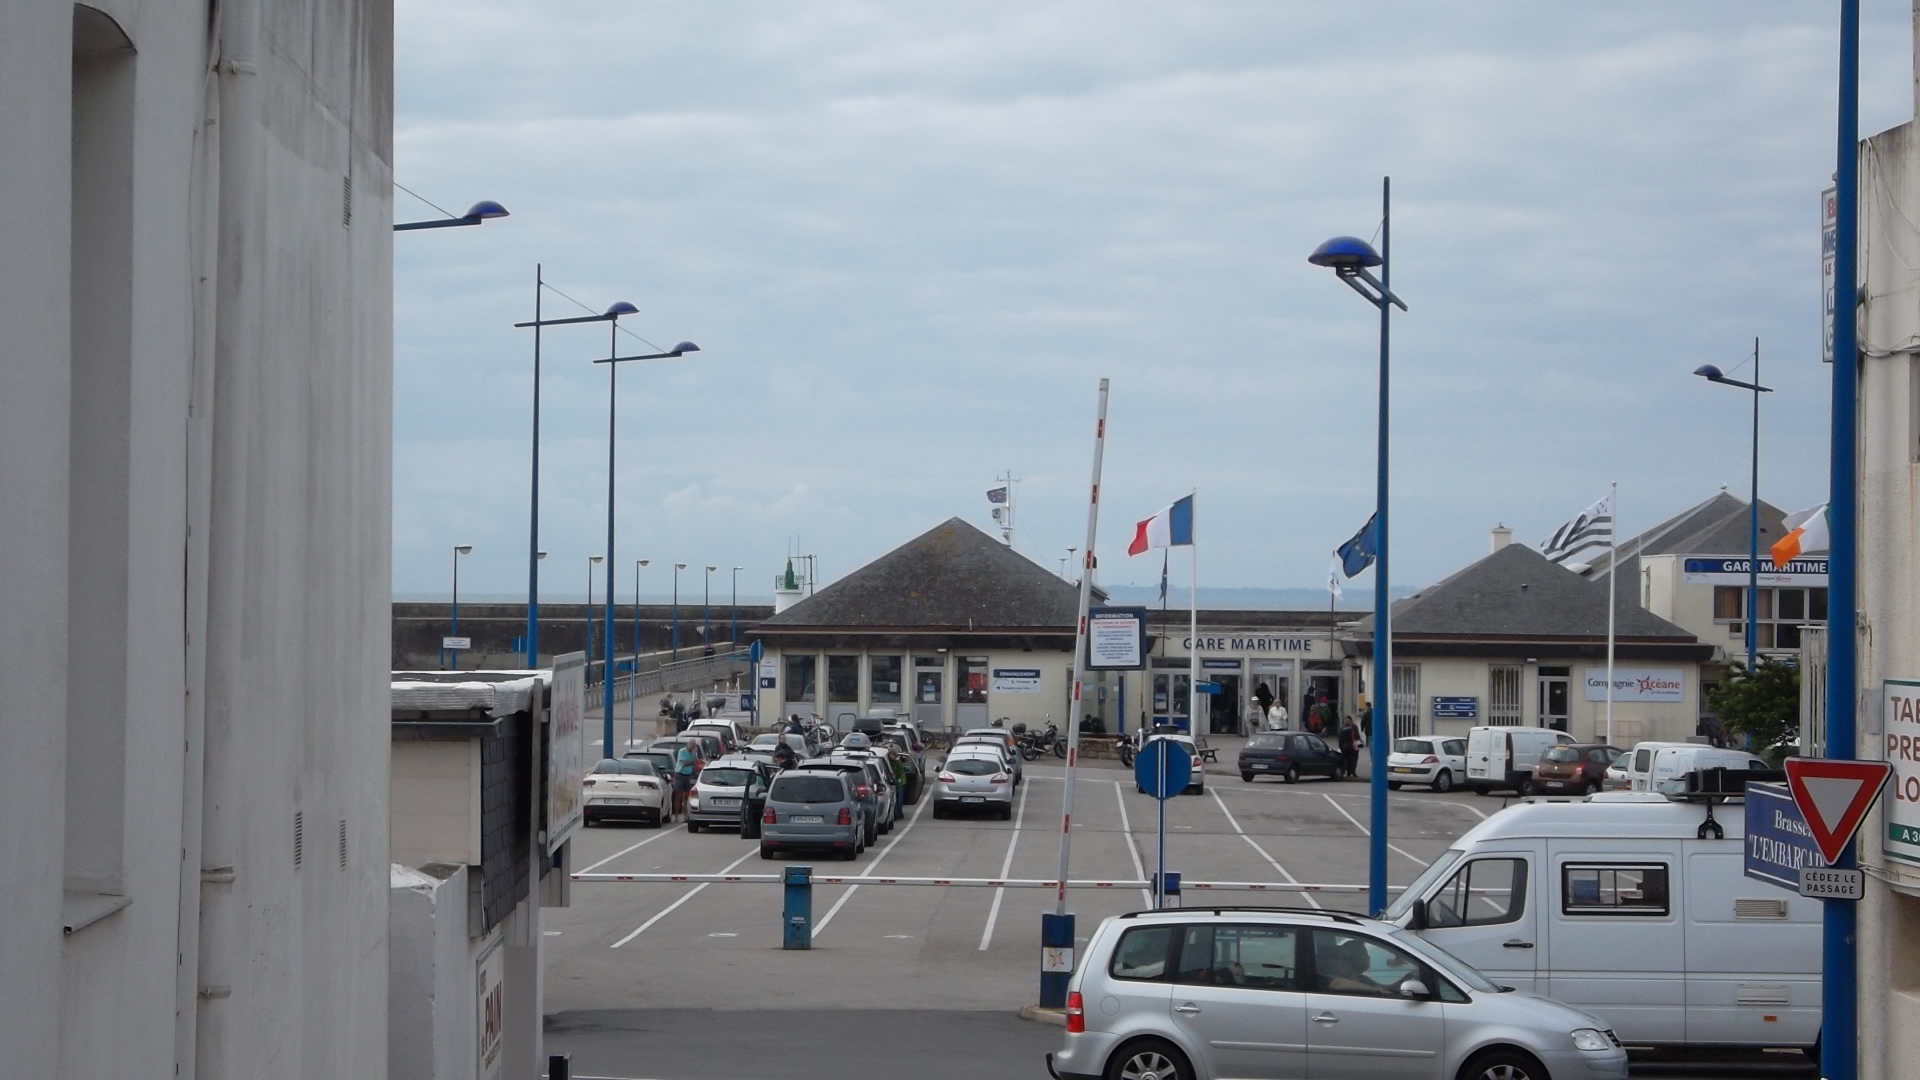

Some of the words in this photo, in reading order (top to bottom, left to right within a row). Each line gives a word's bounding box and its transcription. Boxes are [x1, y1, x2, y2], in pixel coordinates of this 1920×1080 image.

[1723, 561, 1757, 572] GAR
[1183, 638, 1225, 650] GARE
[1231, 639, 1312, 651] MARITIME
[1902, 828, 1910, 842] A
[1806, 871, 1841, 882] CÉDEZ
[1844, 874, 1856, 883] LE
[1807, 883, 1855, 895] PASSAGE
